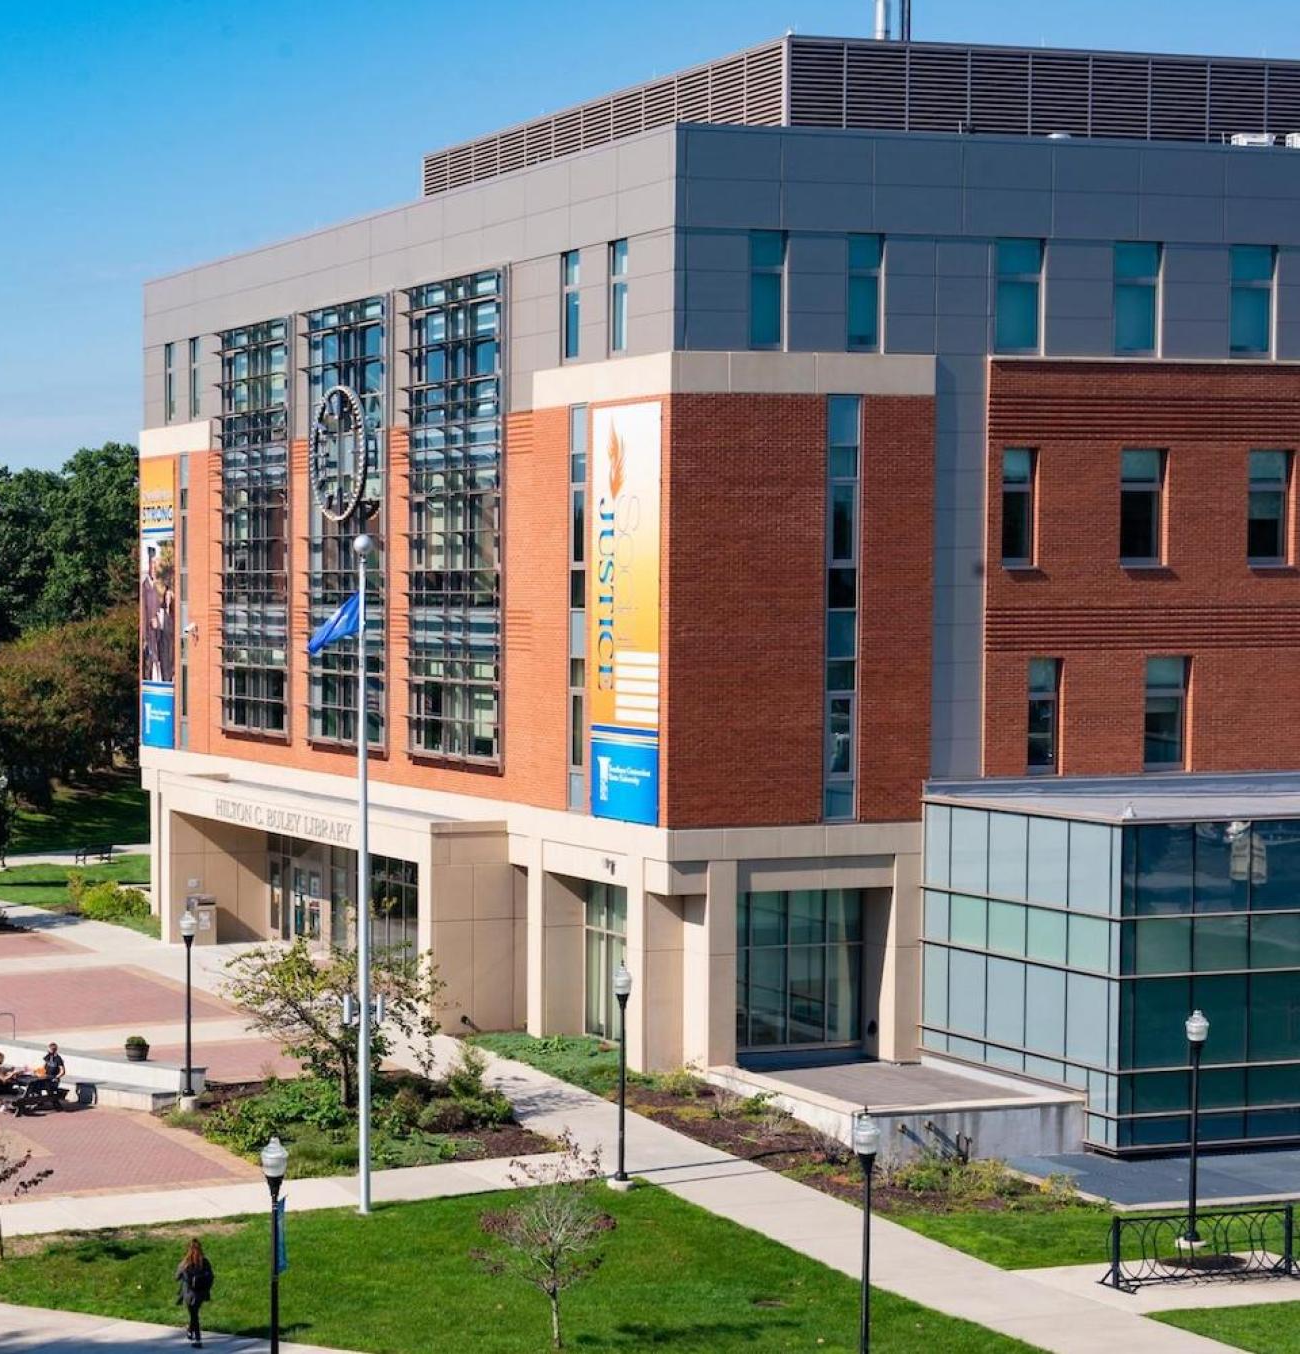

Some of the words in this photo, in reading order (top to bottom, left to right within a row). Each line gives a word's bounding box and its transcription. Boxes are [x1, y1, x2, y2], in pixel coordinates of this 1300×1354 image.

[143, 505, 172, 523] STRONG
[598, 497, 614, 690] JUSTICE
[216, 798, 251, 822] HILTON
[266, 808, 300, 833] BULEY
[304, 815, 351, 842] LIBRARY
